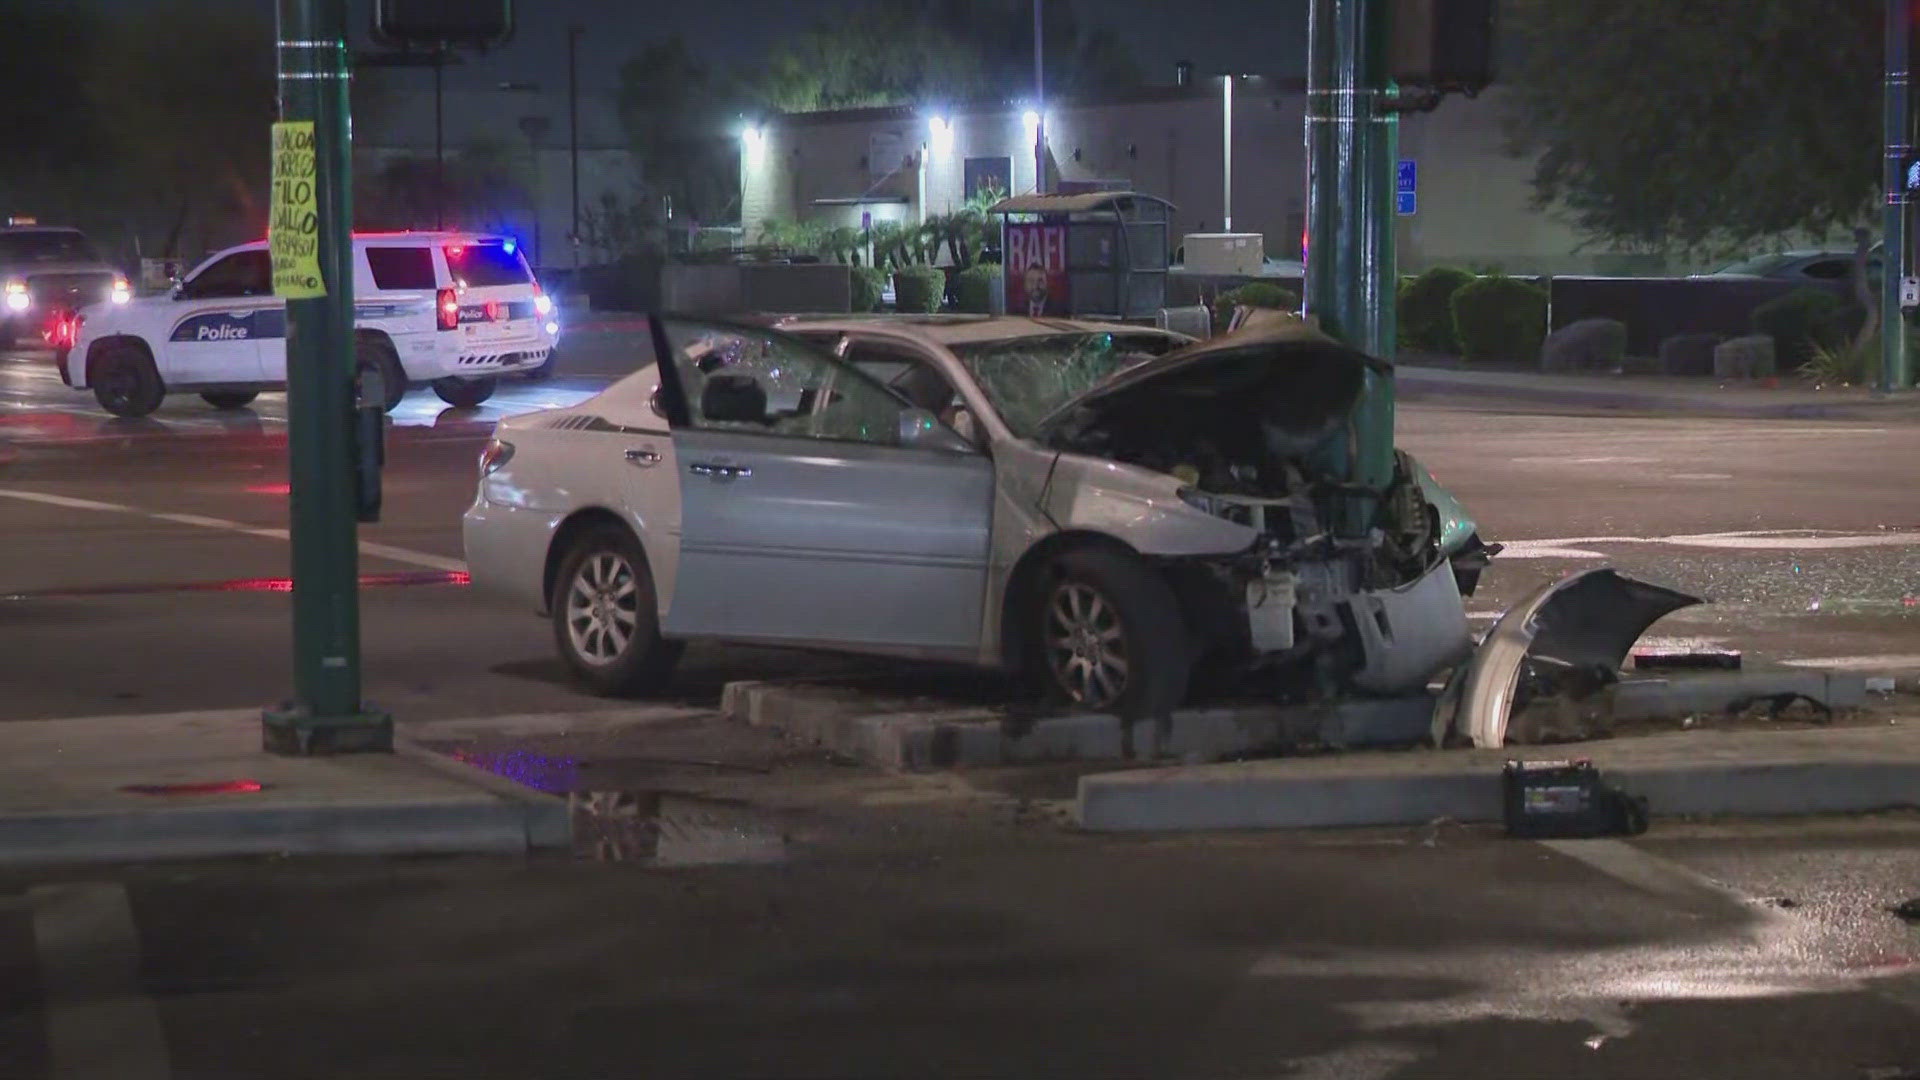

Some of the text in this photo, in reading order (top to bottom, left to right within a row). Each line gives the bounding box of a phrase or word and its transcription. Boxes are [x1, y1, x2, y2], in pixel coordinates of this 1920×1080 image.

[1008, 225, 1066, 275] RAFI
[460, 309, 483, 320] Police
[197, 323, 248, 341] Police
